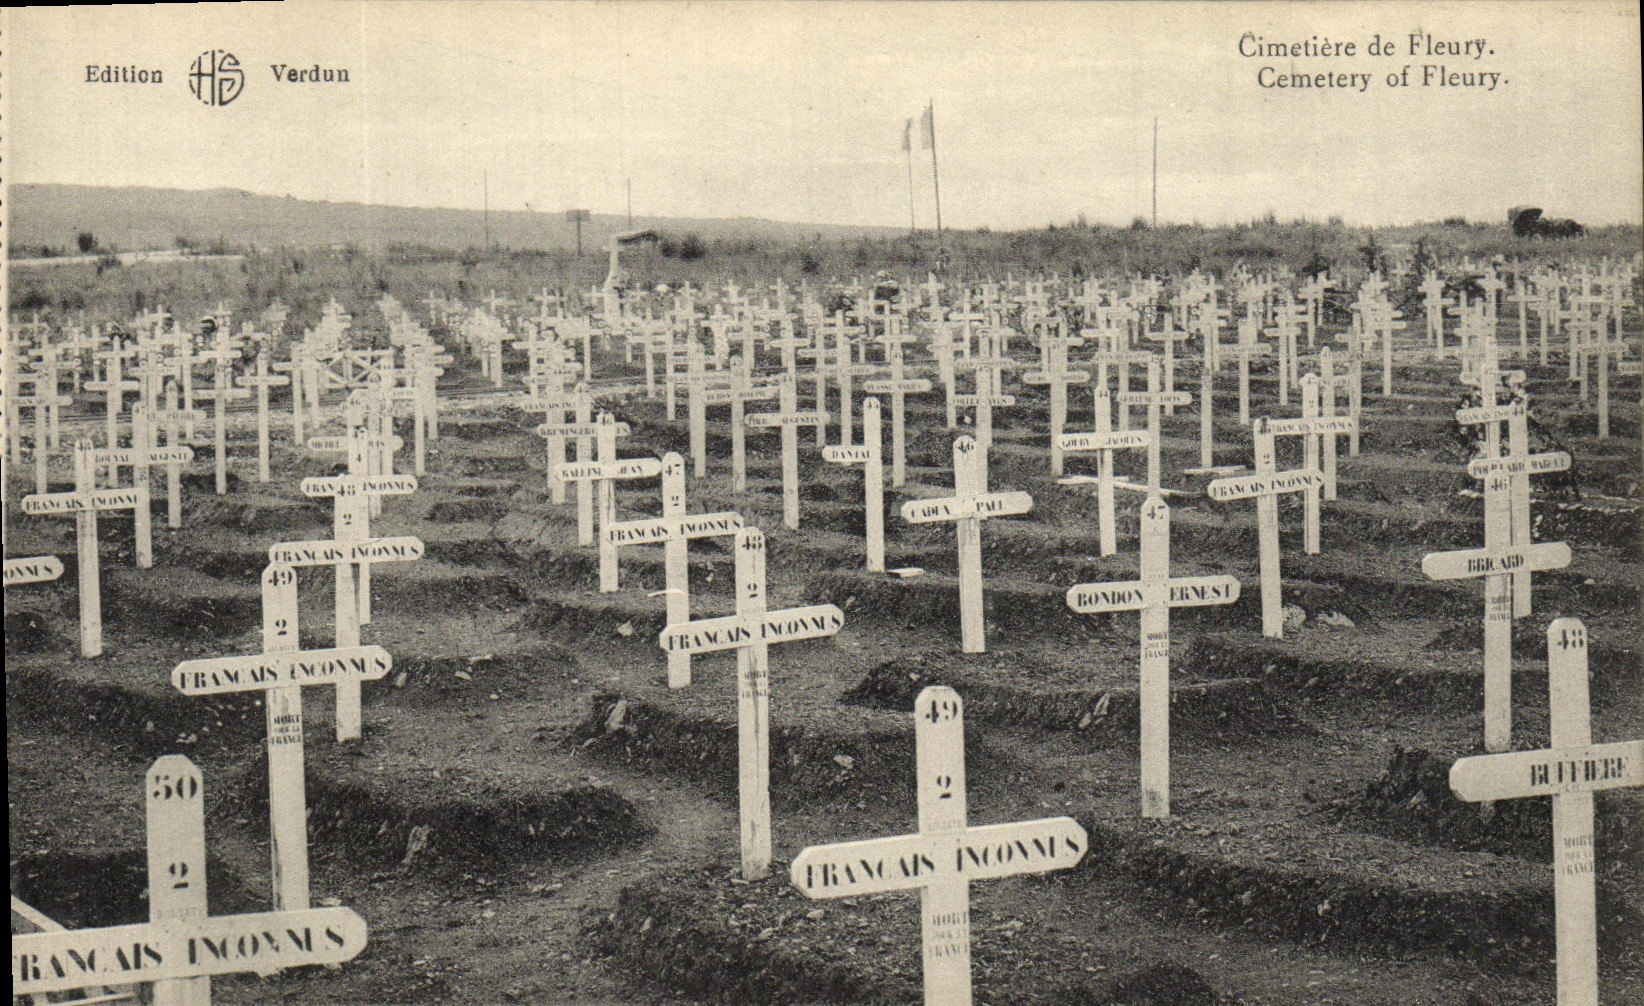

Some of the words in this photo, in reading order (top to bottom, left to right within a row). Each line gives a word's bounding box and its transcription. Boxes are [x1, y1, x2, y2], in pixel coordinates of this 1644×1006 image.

[610, 525, 669, 542] FRANCAIS
[680, 519, 741, 535] INCONNUS
[274, 549, 343, 563] FRANCAIS
[352, 545, 419, 559] INCONNUS
[741, 534, 762, 551] 48
[268, 570, 293, 586] 49
[747, 583, 758, 598] 2
[1170, 583, 1234, 601] ERNEST
[275, 618, 287, 636] 2
[668, 626, 752, 651] FRANCAIS
[761, 616, 841, 639] INCONNUS
[1556, 629, 1584, 650] 48
[180, 665, 278, 689] FRANCAIS
[290, 657, 386, 680] INCONNUS
[926, 700, 958, 723] 49
[153, 775, 198, 801] 50
[936, 775, 952, 799] 2
[806, 853, 935, 889] FRANCAIS
[956, 836, 1080, 873] INCONNUS
[169, 862, 189, 889] 2
[188, 925, 345, 964] INCONNUS
